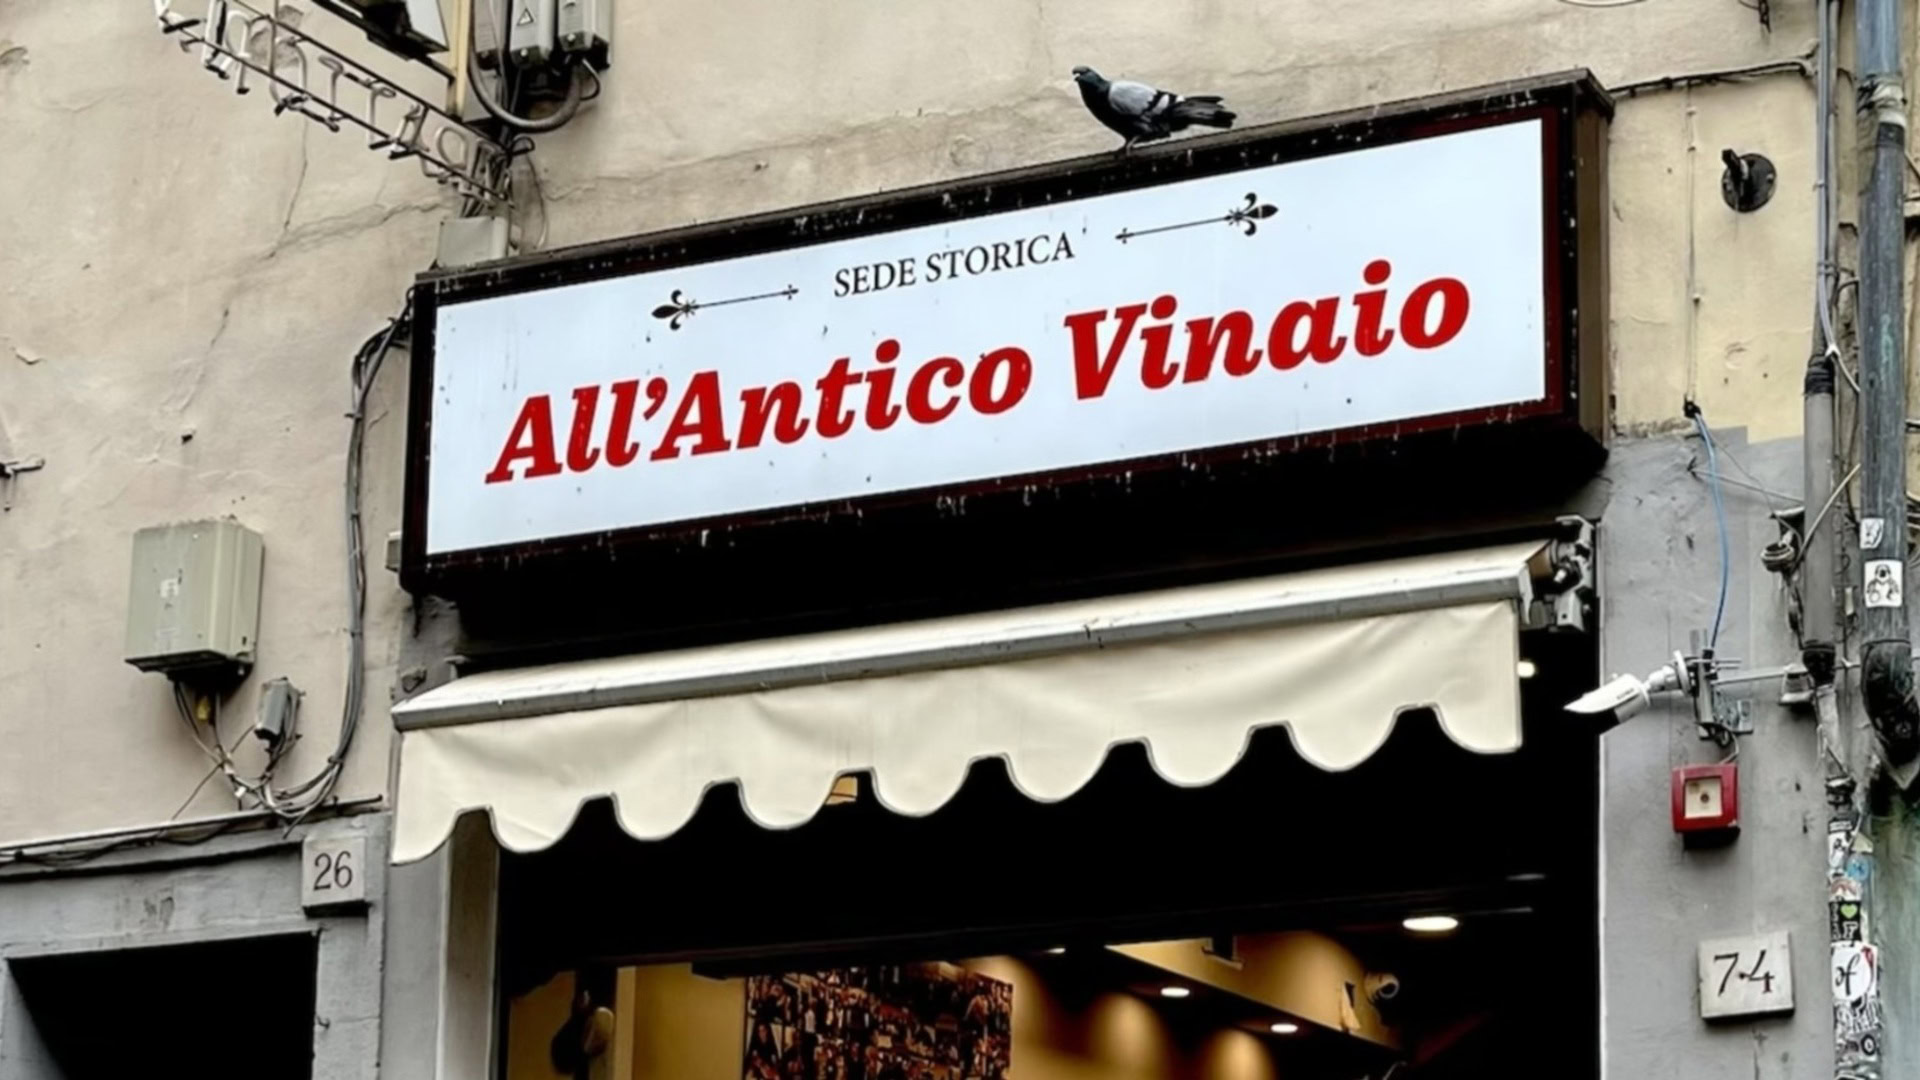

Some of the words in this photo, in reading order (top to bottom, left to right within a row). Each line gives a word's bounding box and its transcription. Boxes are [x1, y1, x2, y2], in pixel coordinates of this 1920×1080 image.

[834, 258, 917, 298] SEDE
[925, 231, 1075, 284] STORICA
[1064, 258, 1471, 400] Vinaio
[313, 850, 353, 891] 26
[1713, 949, 1776, 997] 74
